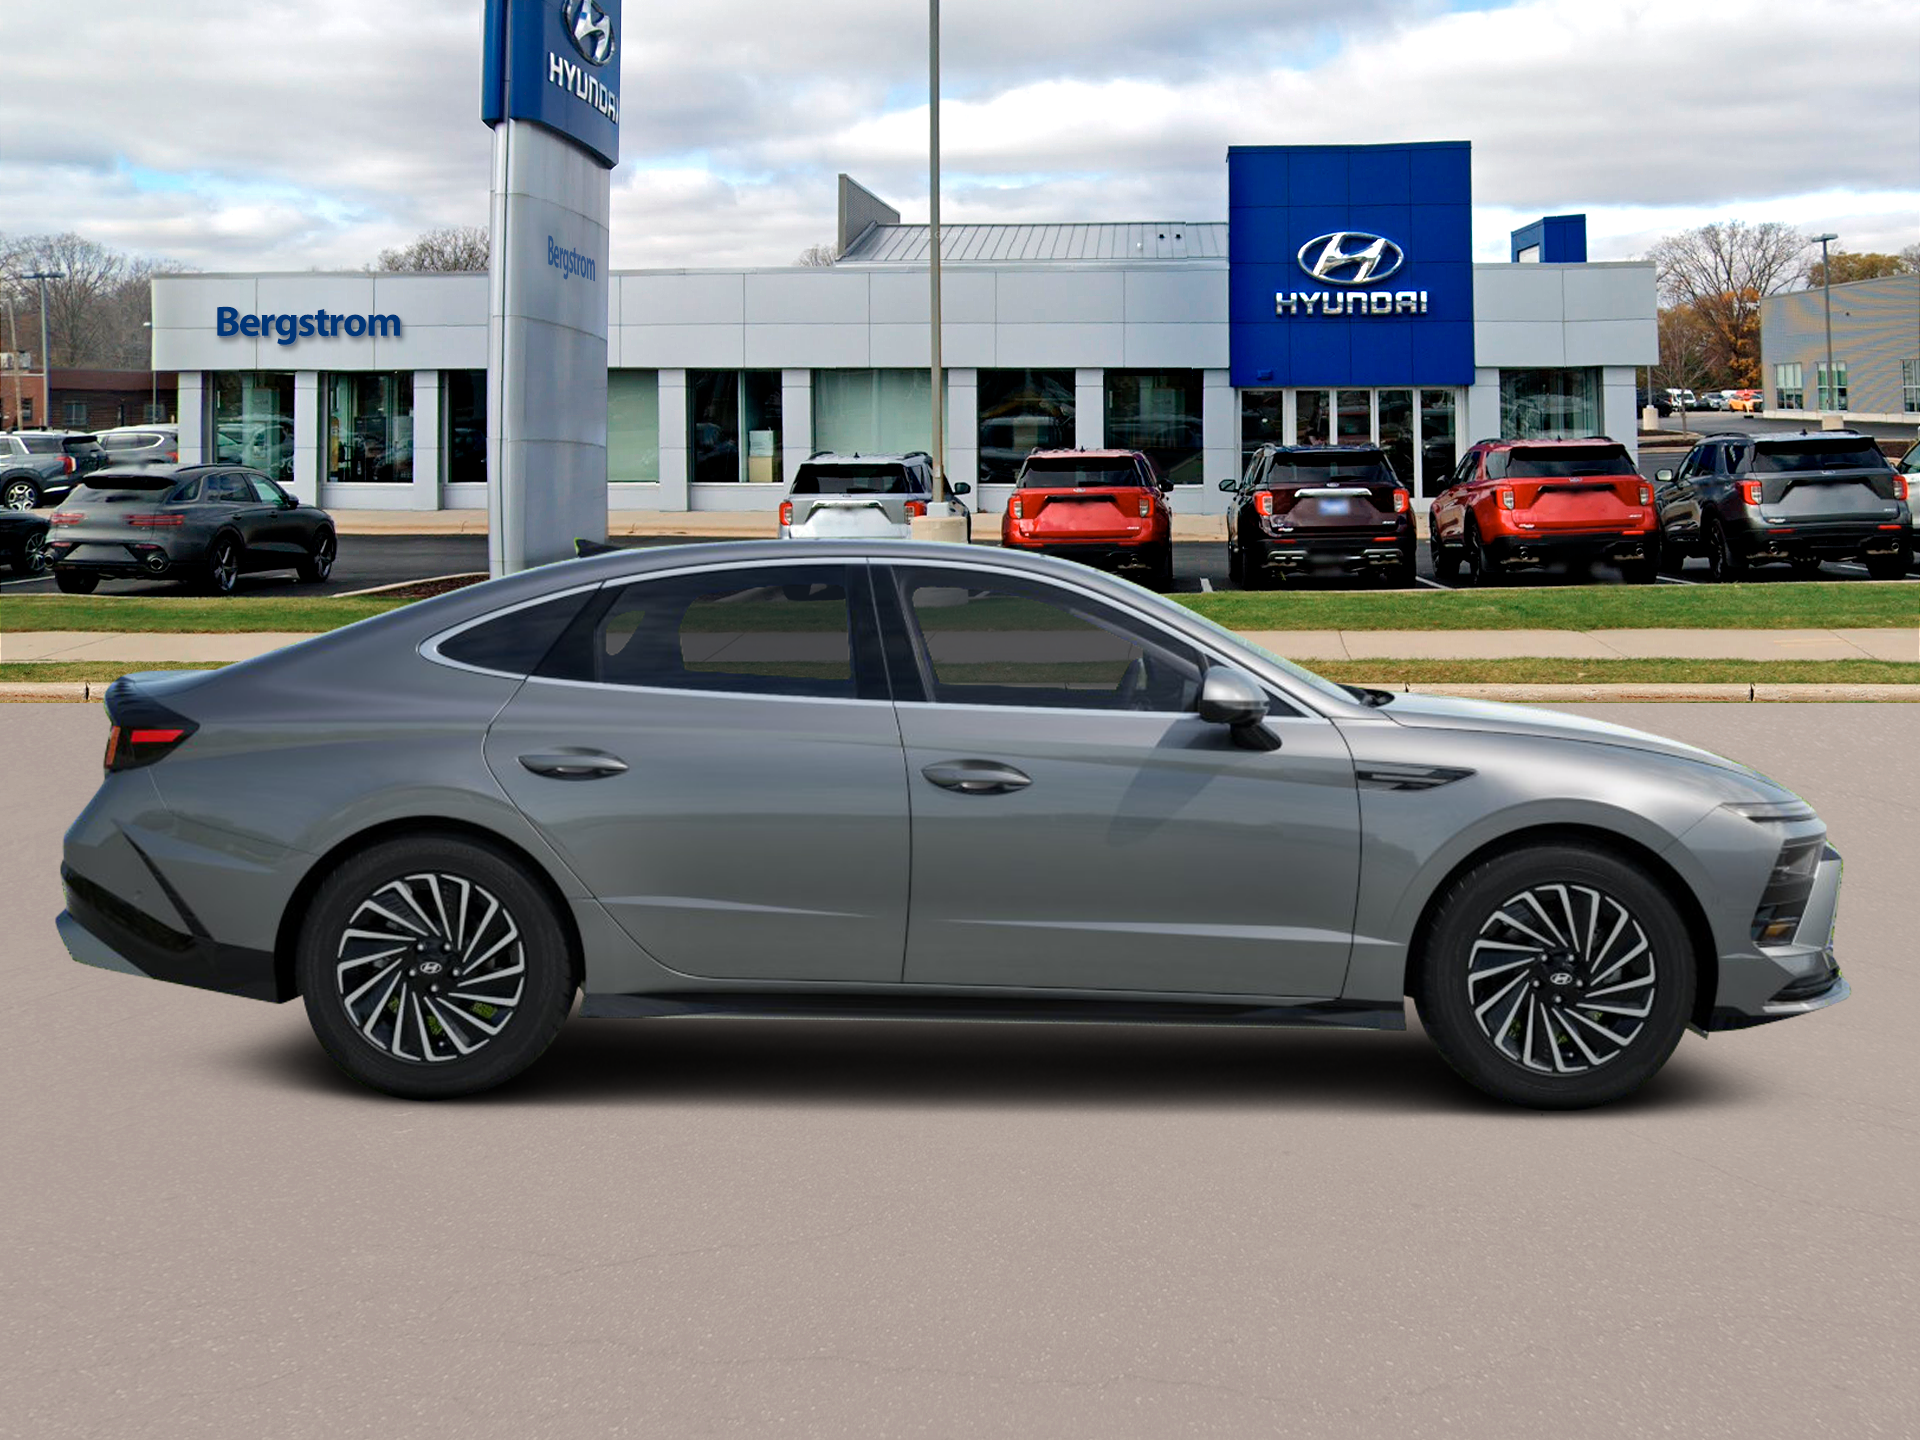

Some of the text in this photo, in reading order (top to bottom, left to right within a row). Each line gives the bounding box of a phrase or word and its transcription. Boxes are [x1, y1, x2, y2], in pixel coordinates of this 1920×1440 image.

[549, 51, 619, 124] HYUNDAI
[547, 235, 596, 282] Bergstrom
[1275, 291, 1428, 315] HYUNDAI
[216, 306, 402, 346] Bergstrom
